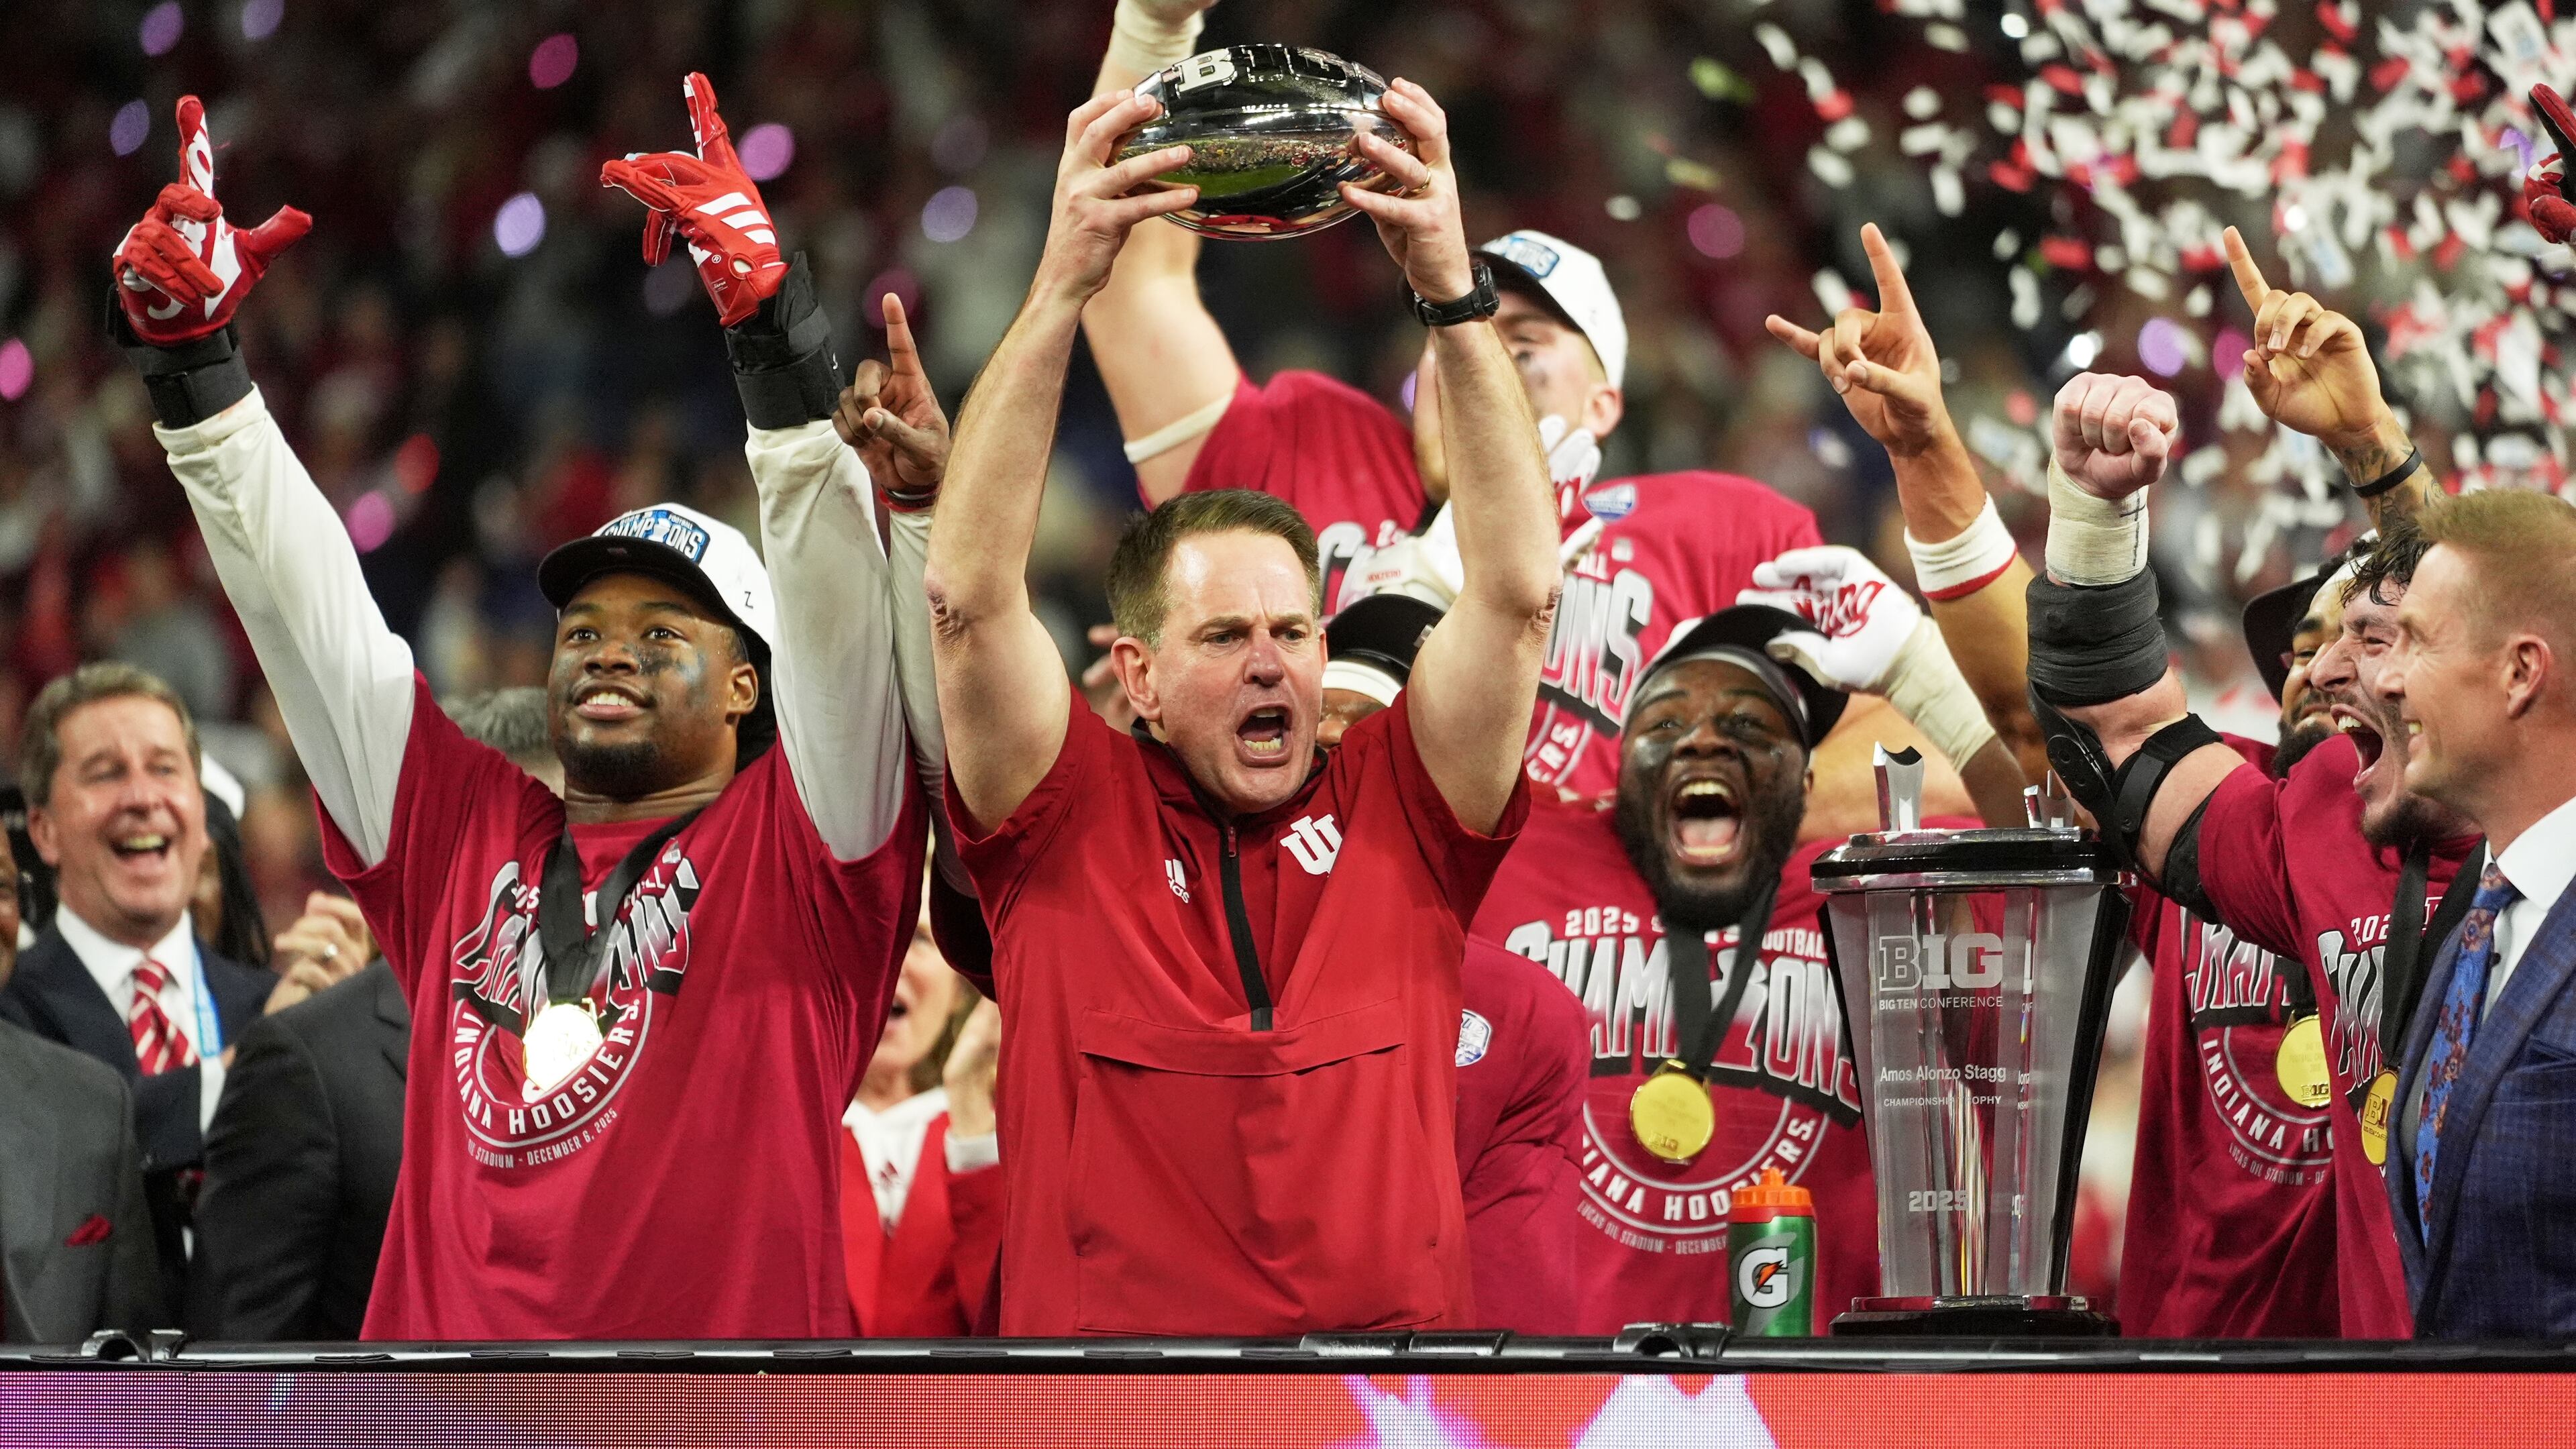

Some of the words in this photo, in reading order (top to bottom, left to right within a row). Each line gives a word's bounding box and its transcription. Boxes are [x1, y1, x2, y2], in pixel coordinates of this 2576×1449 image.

[1762, 928, 1827, 960] OOTBAL
[2351, 914, 2391, 947] 202
[1879, 999, 1896, 1011] BIG
[1897, 999, 1917, 1010] TEN
[1920, 996, 2003, 1009] CONFERENCE
[1880, 1067, 1913, 1082] Amos
[1916, 1065, 1960, 1081] Alonzo
[1964, 1064, 2006, 1083] Stagg
[2203, 1039, 2286, 1150] INDIANA
[1884, 1097, 1955, 1107] CHAMPIONSHIP
[475, 1147, 514, 1169] STADIUM
[527, 1135, 582, 1166] DECEMBER
[594, 1108, 618, 1134] 2025
[1582, 1133, 1645, 1214] IANA
[1664, 1117, 1816, 1221] HOORS
[2229, 1142, 2248, 1169] LUCAS
[2250, 1161, 2263, 1177] OIL
[2265, 1167, 2304, 1186] STADIUM
[1576, 1199, 1607, 1230] LUCAS
[1619, 1230, 1665, 1253] STADIUM
[1737, 1246, 1788, 1309] G
